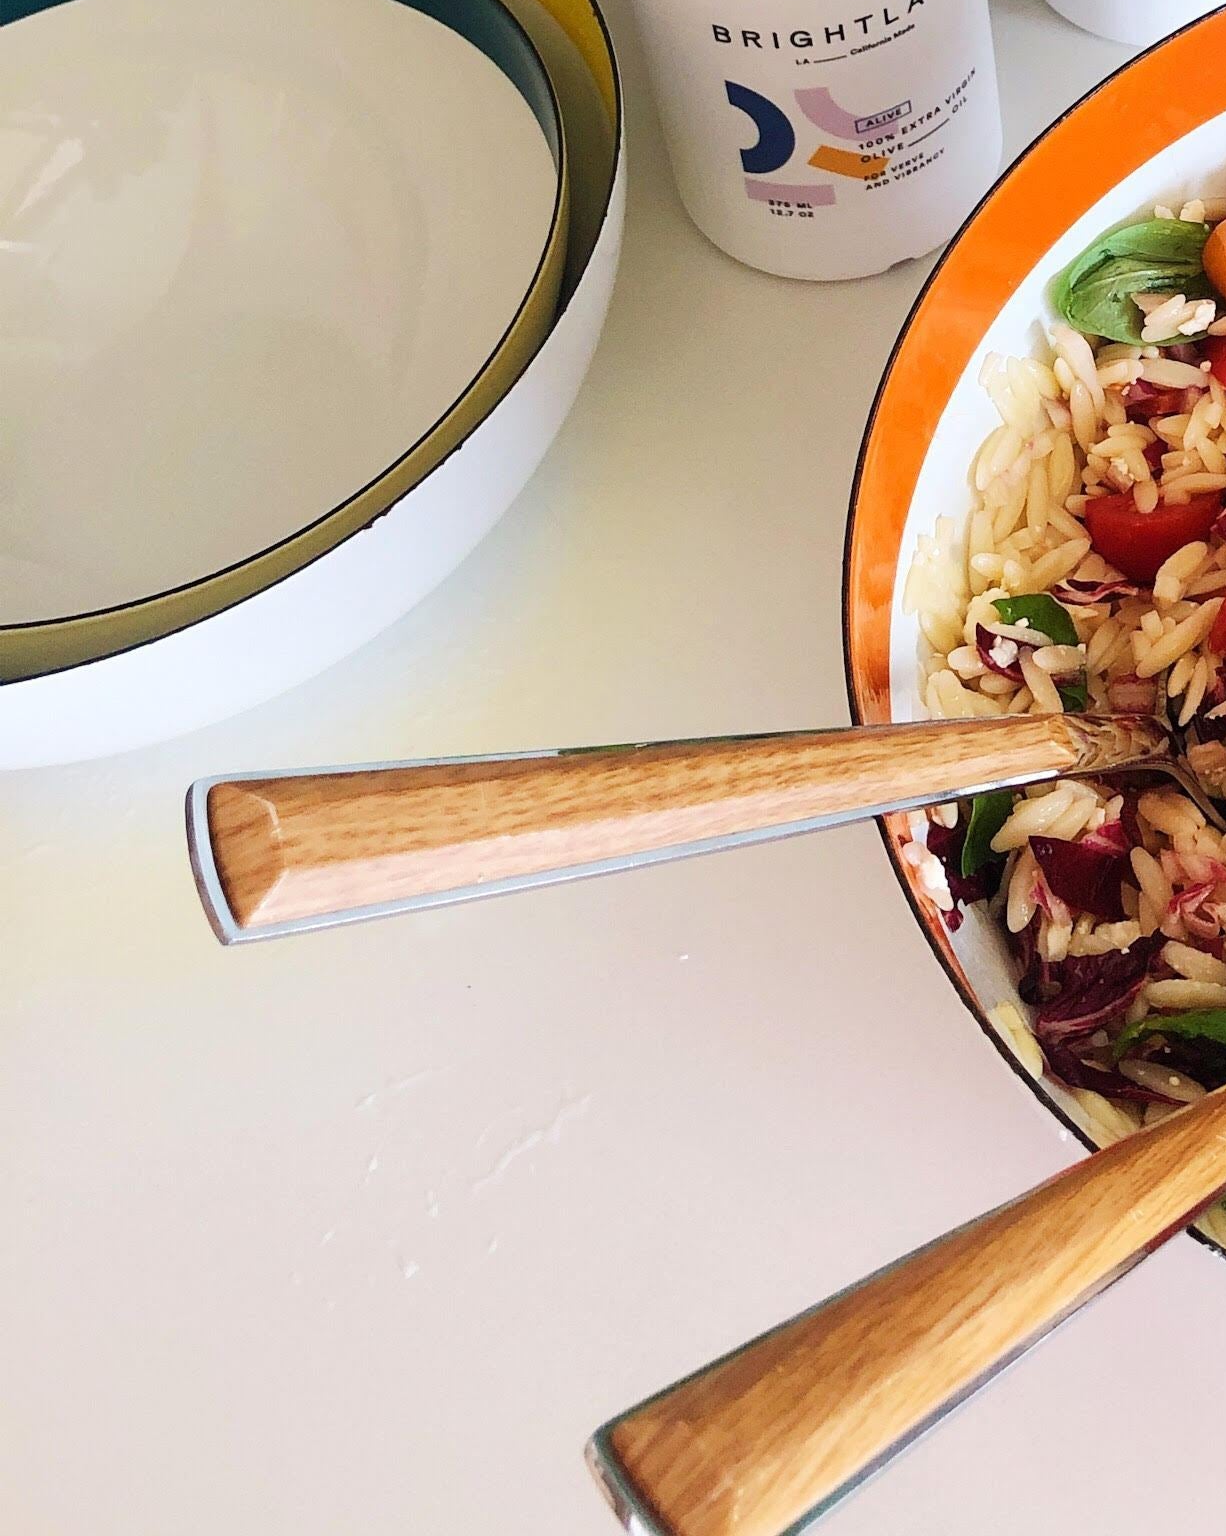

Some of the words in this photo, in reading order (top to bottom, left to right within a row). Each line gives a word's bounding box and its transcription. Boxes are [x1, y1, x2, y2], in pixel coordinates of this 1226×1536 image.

[849, 37, 892, 56] California
[893, 23, 916, 39] Made
[858, 132, 896, 150] 100%
[900, 106, 942, 135] EXTRA
[944, 67, 976, 105] VIRGIN
[865, 107, 903, 128] ALIVE
[860, 142, 905, 163] OLIVE
[951, 96, 968, 114] OIL
[864, 170, 887, 182] FOR
[890, 152, 925, 172] VERVE
[865, 178, 890, 191] AND
[894, 147, 945, 181] VIBRANCY
